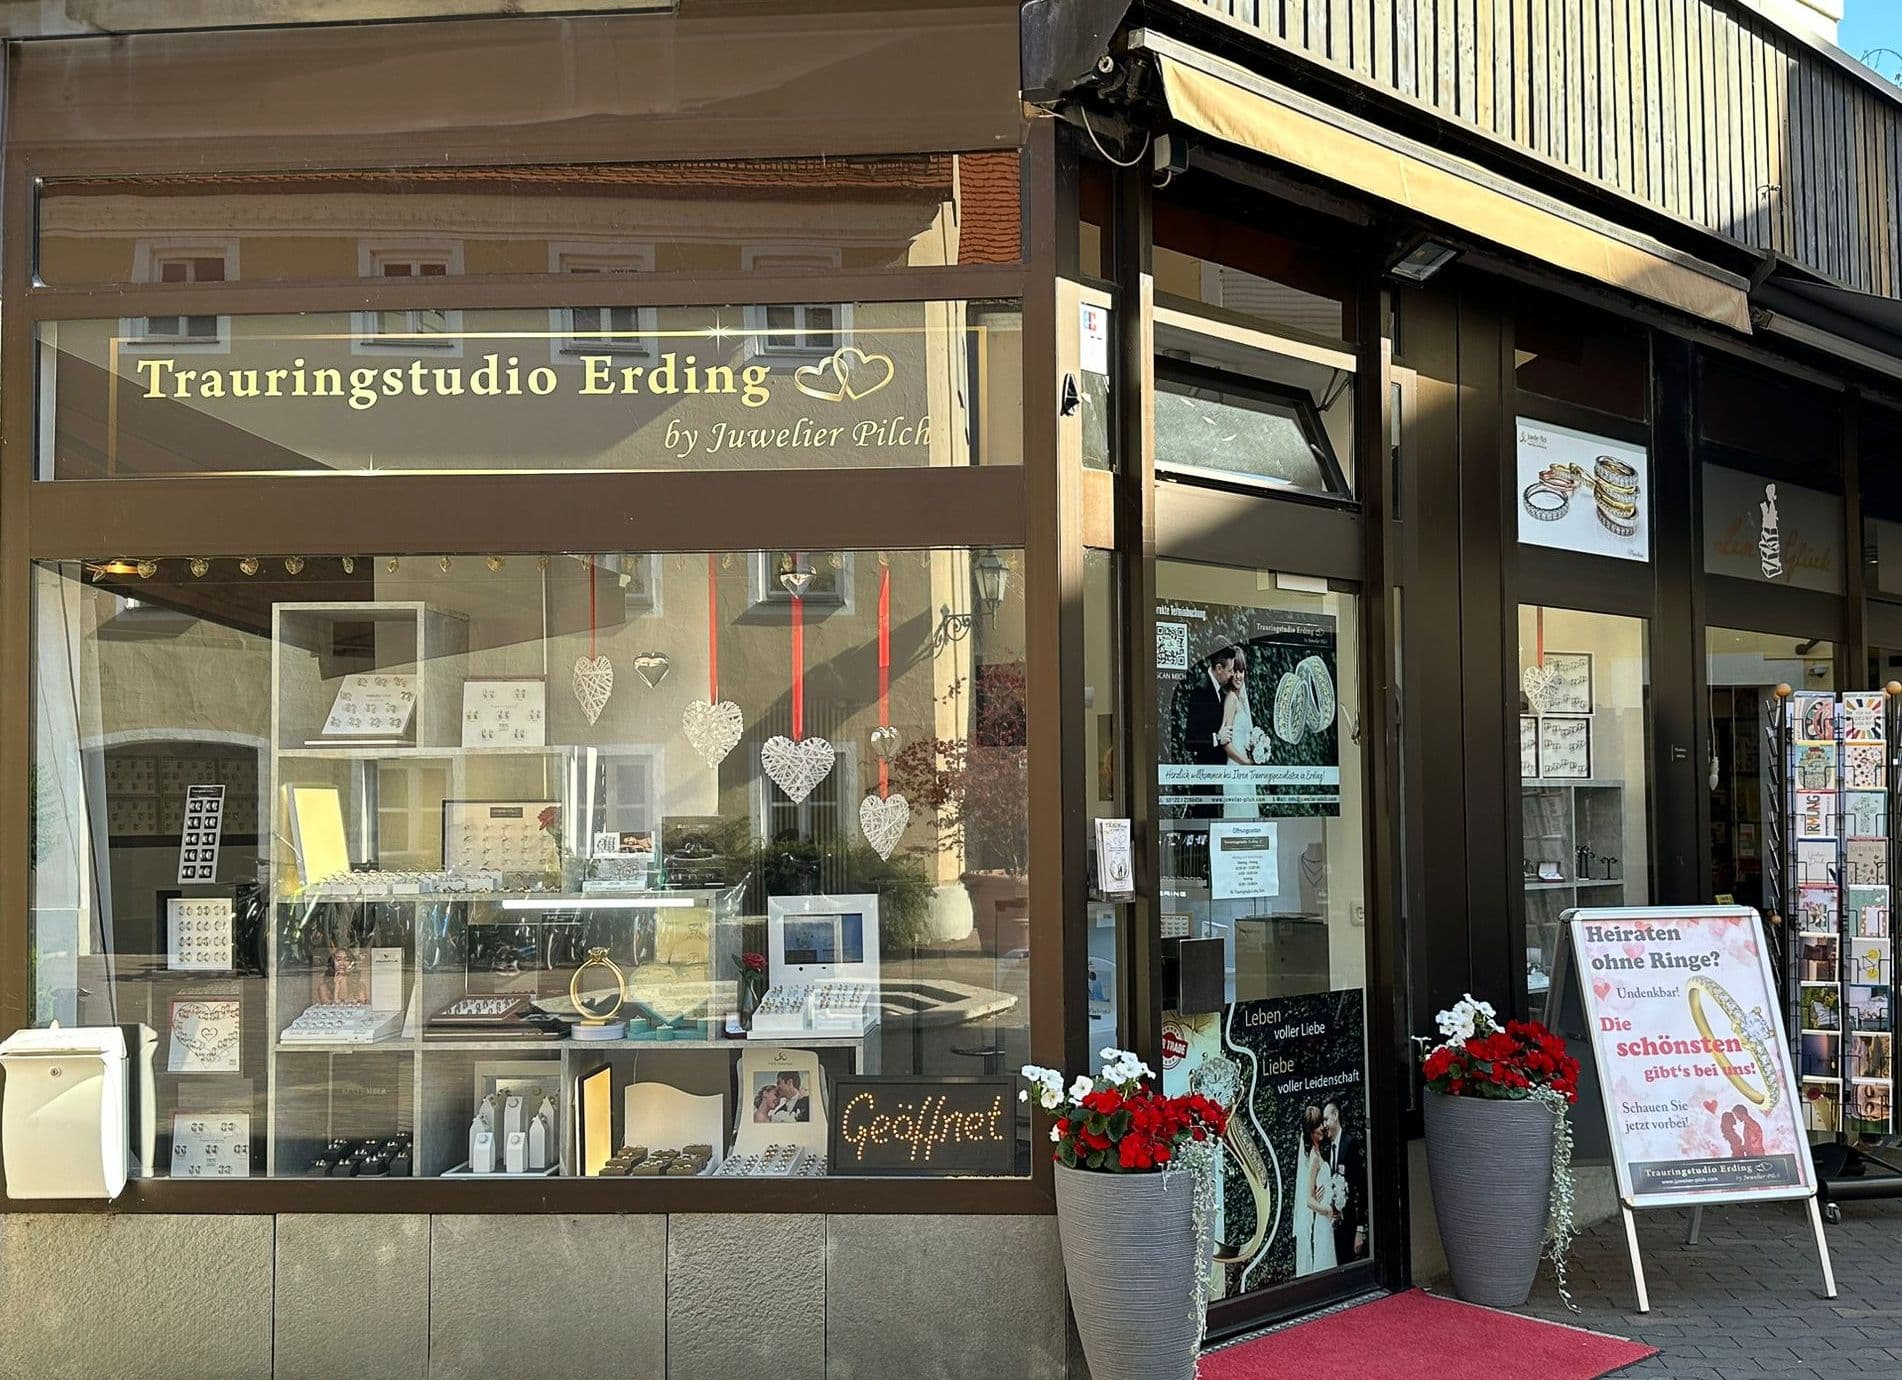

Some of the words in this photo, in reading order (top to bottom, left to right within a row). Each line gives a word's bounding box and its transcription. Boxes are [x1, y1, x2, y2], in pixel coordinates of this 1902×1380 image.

[136, 353, 558, 410] Trauringstudio
[578, 352, 771, 407] Erding
[664, 419, 698, 458] by
[706, 417, 845, 453] Juwelier
[852, 416, 931, 447] Pilch
[1585, 925, 1682, 943] Heiraten
[1591, 953, 1646, 971] ohne
[1650, 951, 1721, 972] Ringe?
[1616, 985, 1681, 999] Undenkbar!
[1244, 1008, 1282, 1028] Leben
[1600, 1016, 1632, 1032] Die
[1274, 1025, 1300, 1040] voller
[1301, 1021, 1326, 1037] Liebe
[1616, 1034, 1743, 1057] schönsten
[1262, 1057, 1295, 1077] Liebe
[1694, 1063, 1719, 1078] bei
[1722, 1062, 1757, 1077] uns!
[1277, 1079, 1303, 1095] voller
[1304, 1069, 1360, 1091] Leidenschaft
[1621, 1101, 1669, 1114] Schauen
[1670, 1100, 1689, 1112] Sie
[842, 1092, 1003, 1161] Geöffnet
[1624, 1117, 1651, 1134] jetzt
[1651, 1116, 1689, 1131] vorbei!
[1645, 1165, 1718, 1177] Trauringstudio
[1720, 1163, 1753, 1174] Erding
